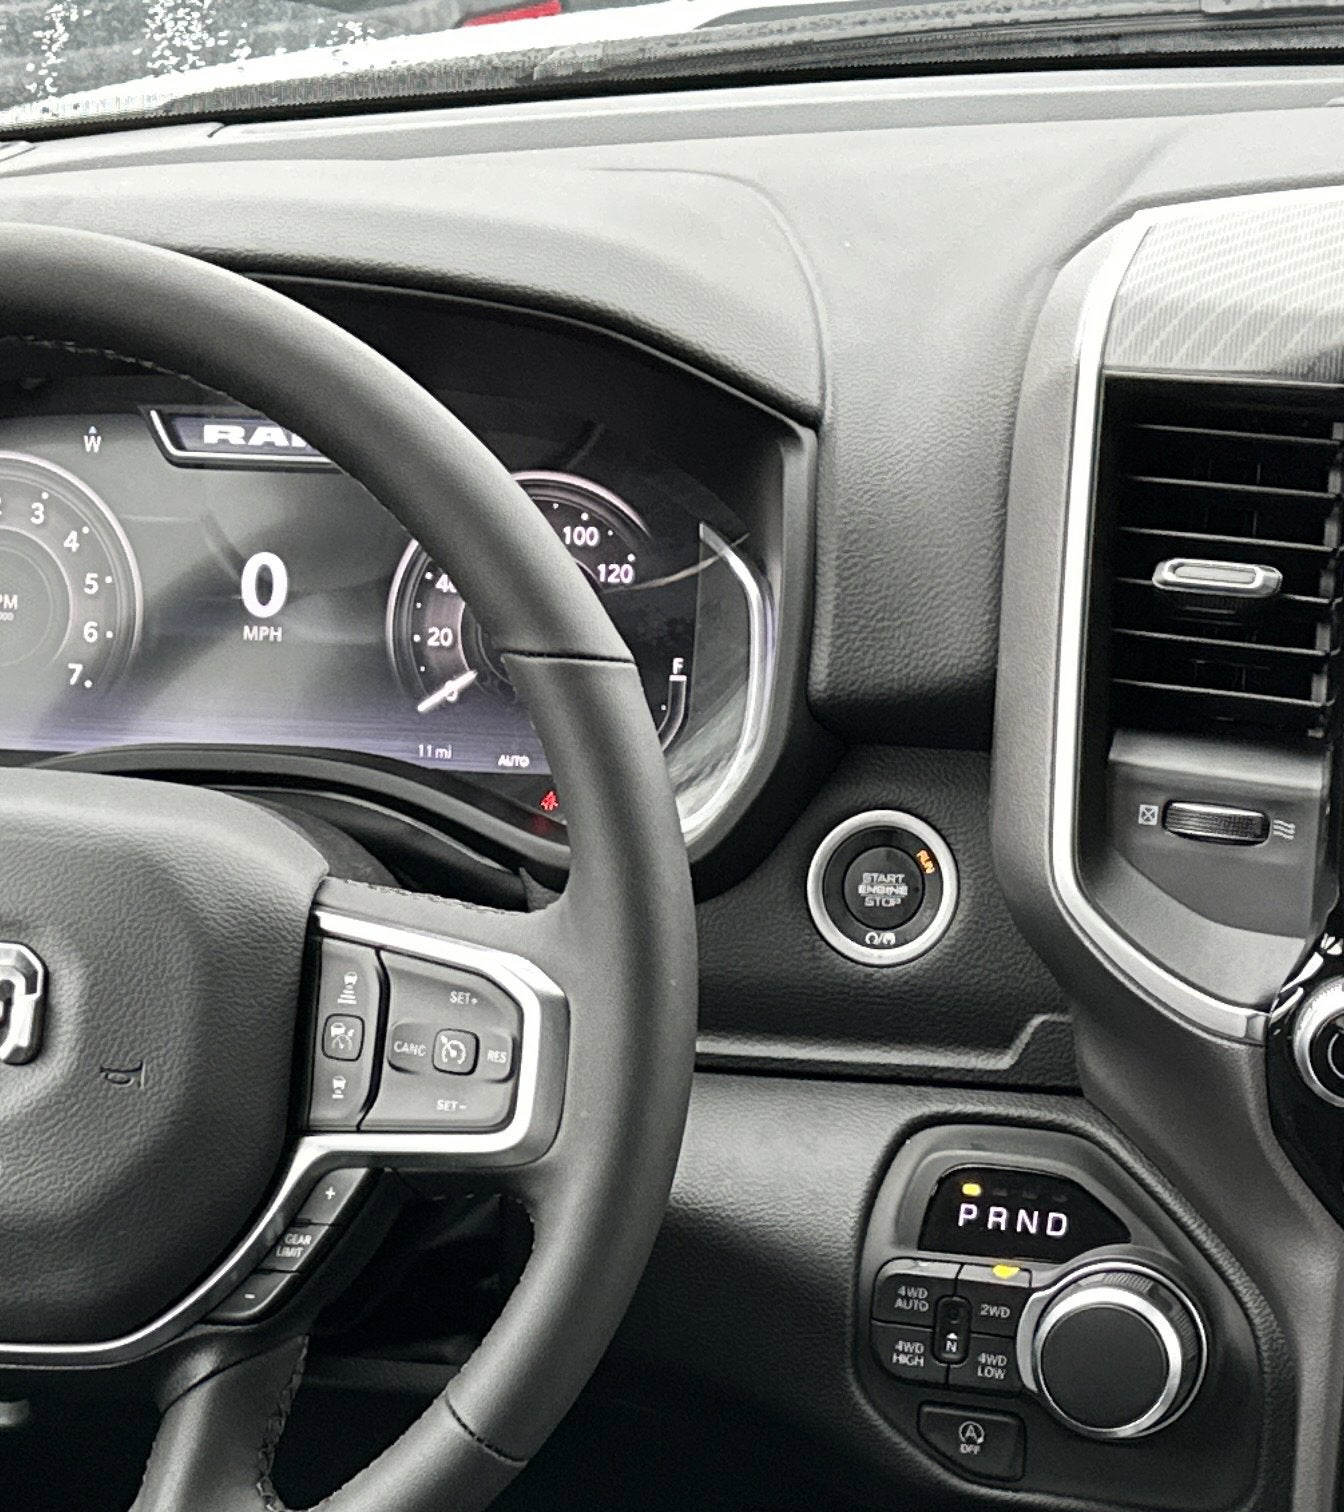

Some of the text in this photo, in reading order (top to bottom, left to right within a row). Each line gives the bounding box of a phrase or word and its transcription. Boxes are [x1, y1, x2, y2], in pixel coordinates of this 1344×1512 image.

[83, 435, 102, 453] W
[31, 503, 45, 525] 3
[63, 531, 80, 552] 4
[563, 526, 600, 547] 100
[597, 563, 634, 584] 120
[83, 573, 99, 594] 5
[241, 551, 288, 618] 0
[83, 622, 99, 643] 6
[243, 625, 283, 642] MPH
[427, 626, 453, 647] 20
[68, 663, 84, 685] 7
[672, 657, 685, 675] F
[417, 744, 452, 760] 11 mi
[497, 754, 531, 768] AUTO
[862, 872, 906, 885] START
[858, 884, 909, 896] ENGINE
[864, 896, 902, 908] STOP
[393, 1040, 427, 1058] CANC
[487, 1049, 508, 1064] RES
[284, 1233, 312, 1246] GEAR
[276, 1246, 305, 1259] LIMIT
[897, 1286, 929, 1300] 4WD
[894, 1299, 930, 1313] AUTO
[979, 1303, 1011, 1319] 2WD
[894, 1340, 925, 1354] 4WD
[945, 1339, 958, 1353] N
[891, 1352, 925, 1368] HIGH
[977, 1352, 1008, 1367] 4WD
[977, 1366, 1007, 1380] LOW
[960, 1443, 982, 1455] OFF
